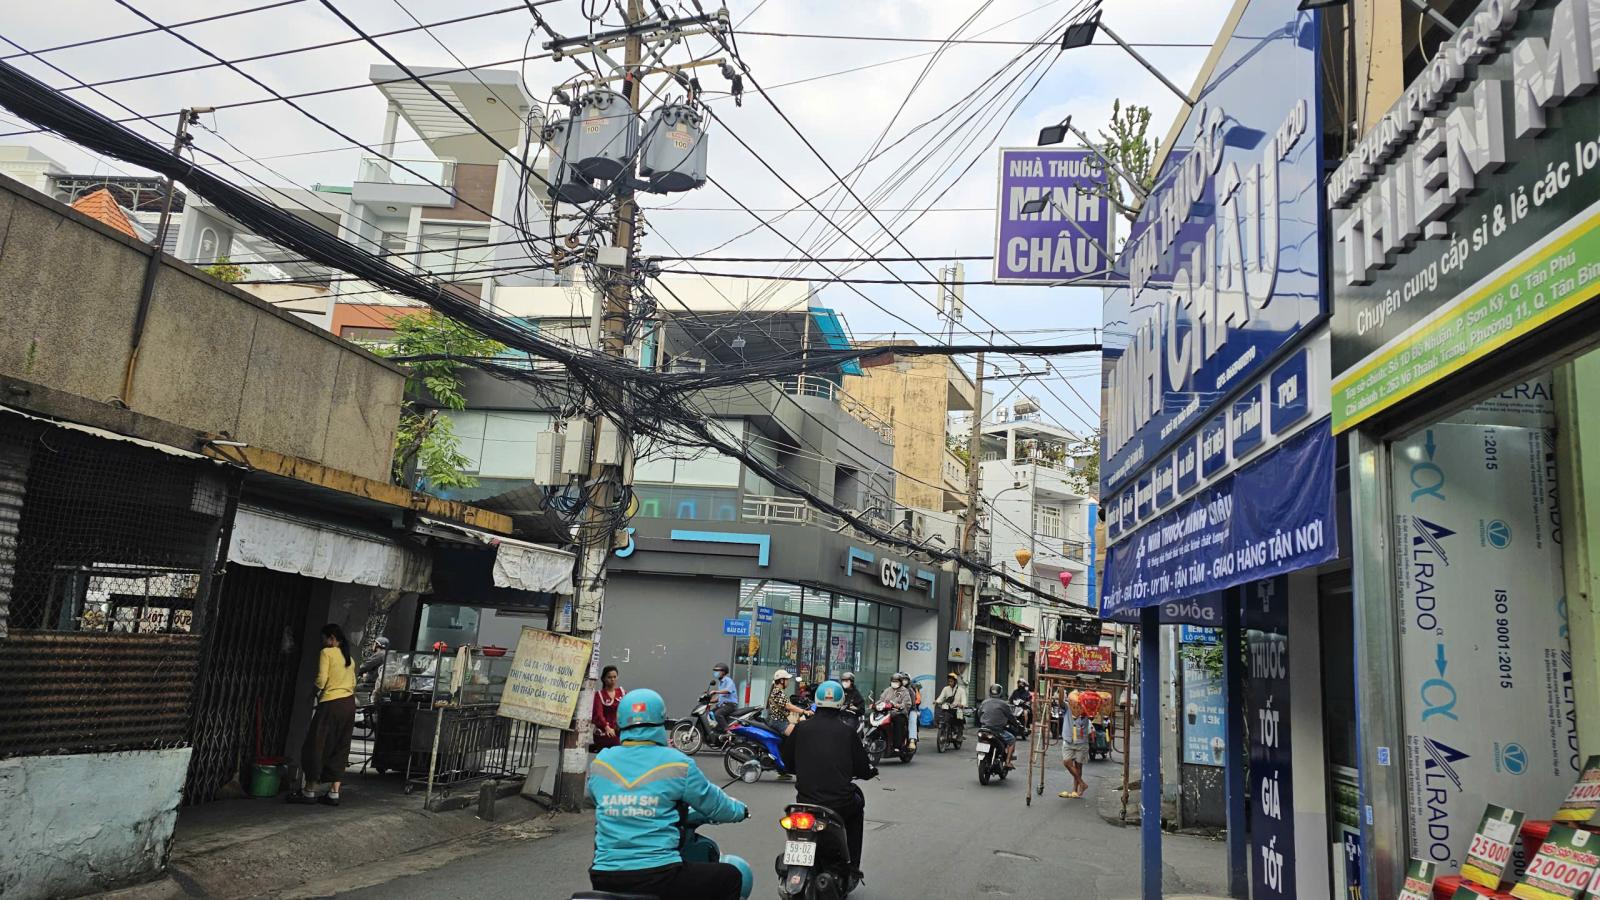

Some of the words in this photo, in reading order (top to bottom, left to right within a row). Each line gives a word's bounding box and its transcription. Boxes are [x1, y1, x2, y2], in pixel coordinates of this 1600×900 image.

[1009, 157, 1043, 177] NHÀ
[1049, 157, 1101, 178] THUỐC
[1328, 153, 1368, 211] NHÀ
[1359, 116, 1415, 176] PHÂN
[1009, 187, 1100, 222] MINH
[1130, 209, 1159, 307] NHÀ
[1161, 101, 1225, 256] THUỐC
[1006, 231, 1098, 273] CHÂU
[1357, 289, 1401, 336] Chuyên
[1404, 260, 1437, 302] cung
[1441, 232, 1468, 274] cấp
[1472, 215, 1488, 252] sỉ
[1492, 204, 1506, 237] &
[1510, 185, 1528, 225] lẻ
[1533, 161, 1571, 207] các
[1575, 134, 1600, 177] lo
[1106, 302, 1163, 462] MINH
[1167, 138, 1280, 392] CHÂU
[1388, 357, 1399, 374] Số
[1456, 317, 1465, 333] P.
[1467, 306, 1488, 327] Sơn
[1509, 283, 1522, 300] Q.
[1525, 268, 1548, 290] Tân
[1550, 248, 1576, 276] Phú
[1470, 314, 1512, 347] Phường
[1516, 301, 1531, 320] 11,
[1534, 292, 1547, 310] Q.
[1550, 277, 1575, 300] Tân
[1578, 260, 1600, 286] Bìn
[1184, 508, 1207, 538] MINH
[880, 556, 910, 592] GS25
[1133, 573, 1148, 599] TỐT
[1189, 560, 1206, 585] TÂM
[1213, 552, 1234, 579] GIAO
[1237, 539, 1267, 571] HÀNG
[1268, 528, 1292, 567] TẬN
[1295, 519, 1324, 550] NƠI
[1412, 515, 1457, 632] ALRADO
[1494, 588, 1508, 614] ISO
[542, 660, 555, 673] TÔM
[557, 662, 574, 677] SƯỜN
[905, 641, 933, 651] GS25
[1250, 626, 1286, 679] THUỐC
[1497, 618, 1513, 689] 9001:2015
[1259, 694, 1280, 748] TỐT
[602, 794, 638, 807] XANH
[639, 795, 658, 806] SM
[1261, 770, 1281, 820] GIÁ
[1423, 736, 1470, 863] ALRADO
[1262, 835, 1284, 894] TỐT
[1471, 836, 1510, 863] 25000
[1530, 857, 1591, 887] 20000
